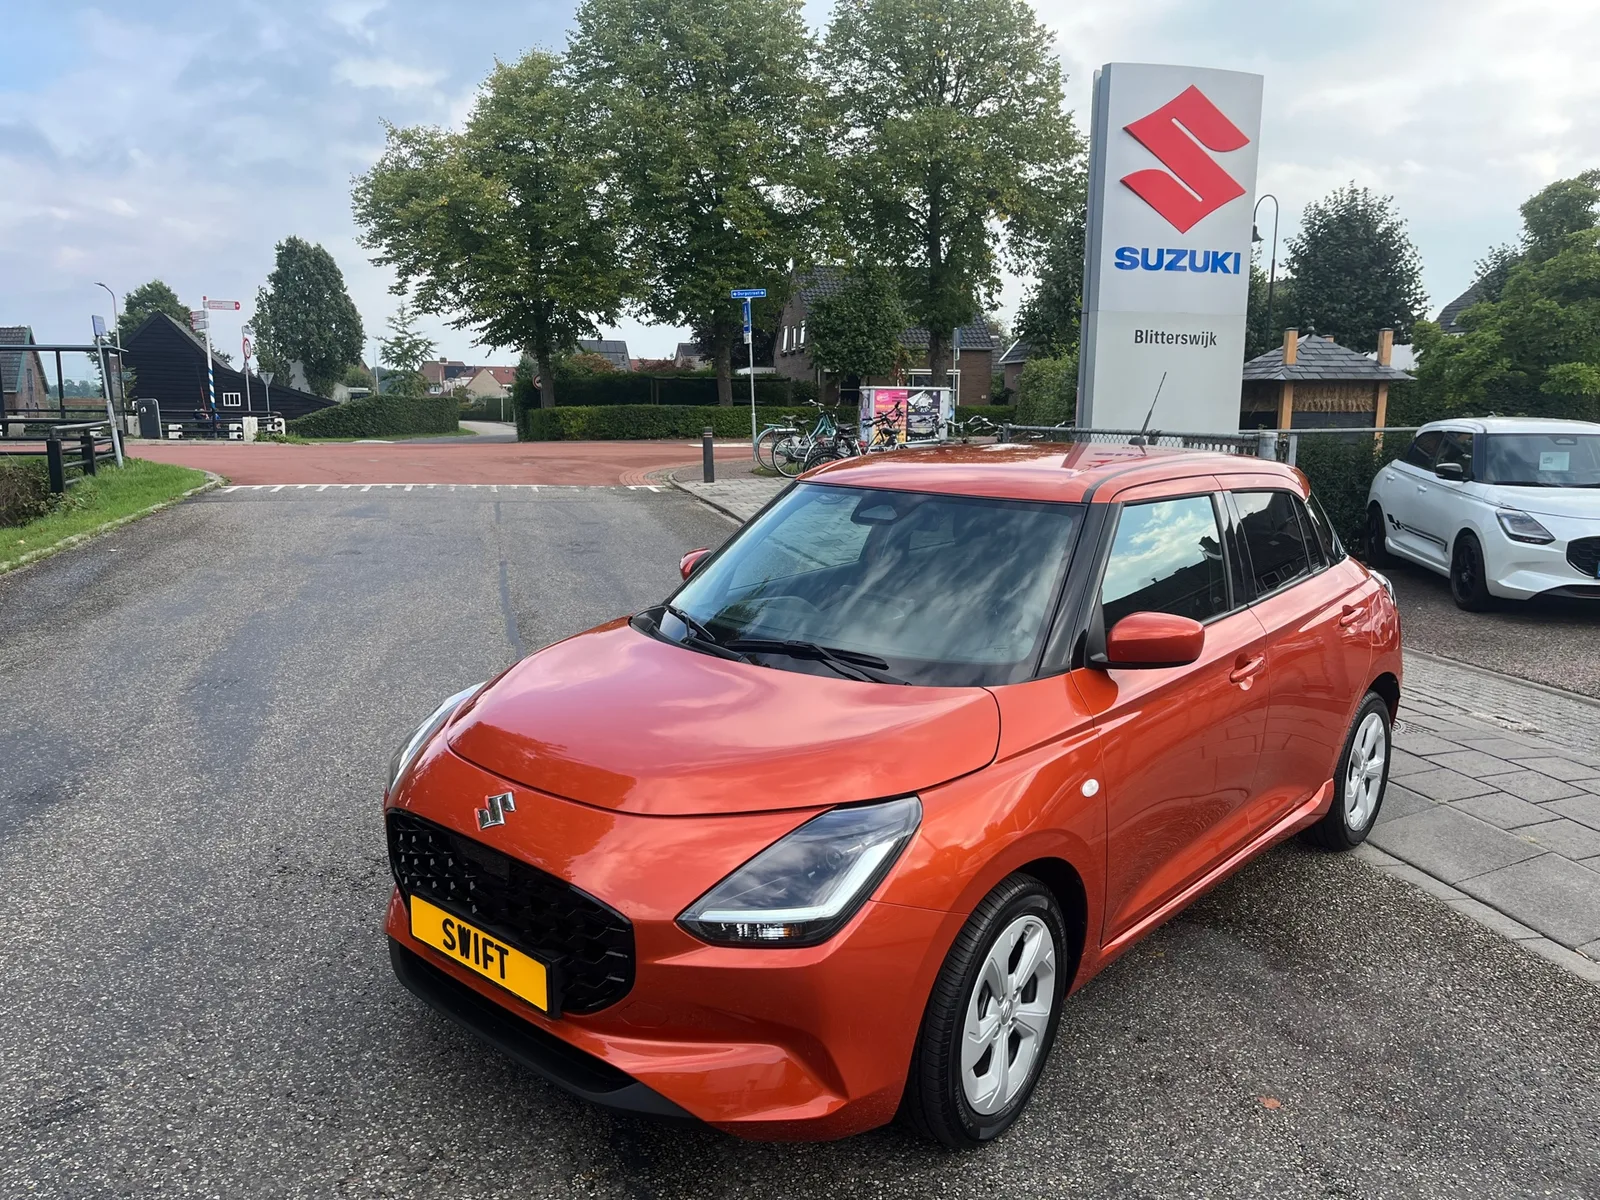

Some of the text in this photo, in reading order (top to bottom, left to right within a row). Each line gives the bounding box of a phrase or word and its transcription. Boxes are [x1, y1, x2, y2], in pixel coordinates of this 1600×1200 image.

[1114, 246, 1241, 275] SUZUKI
[1134, 329, 1217, 348] Blitterswijk
[442, 918, 509, 980] SWIFT
